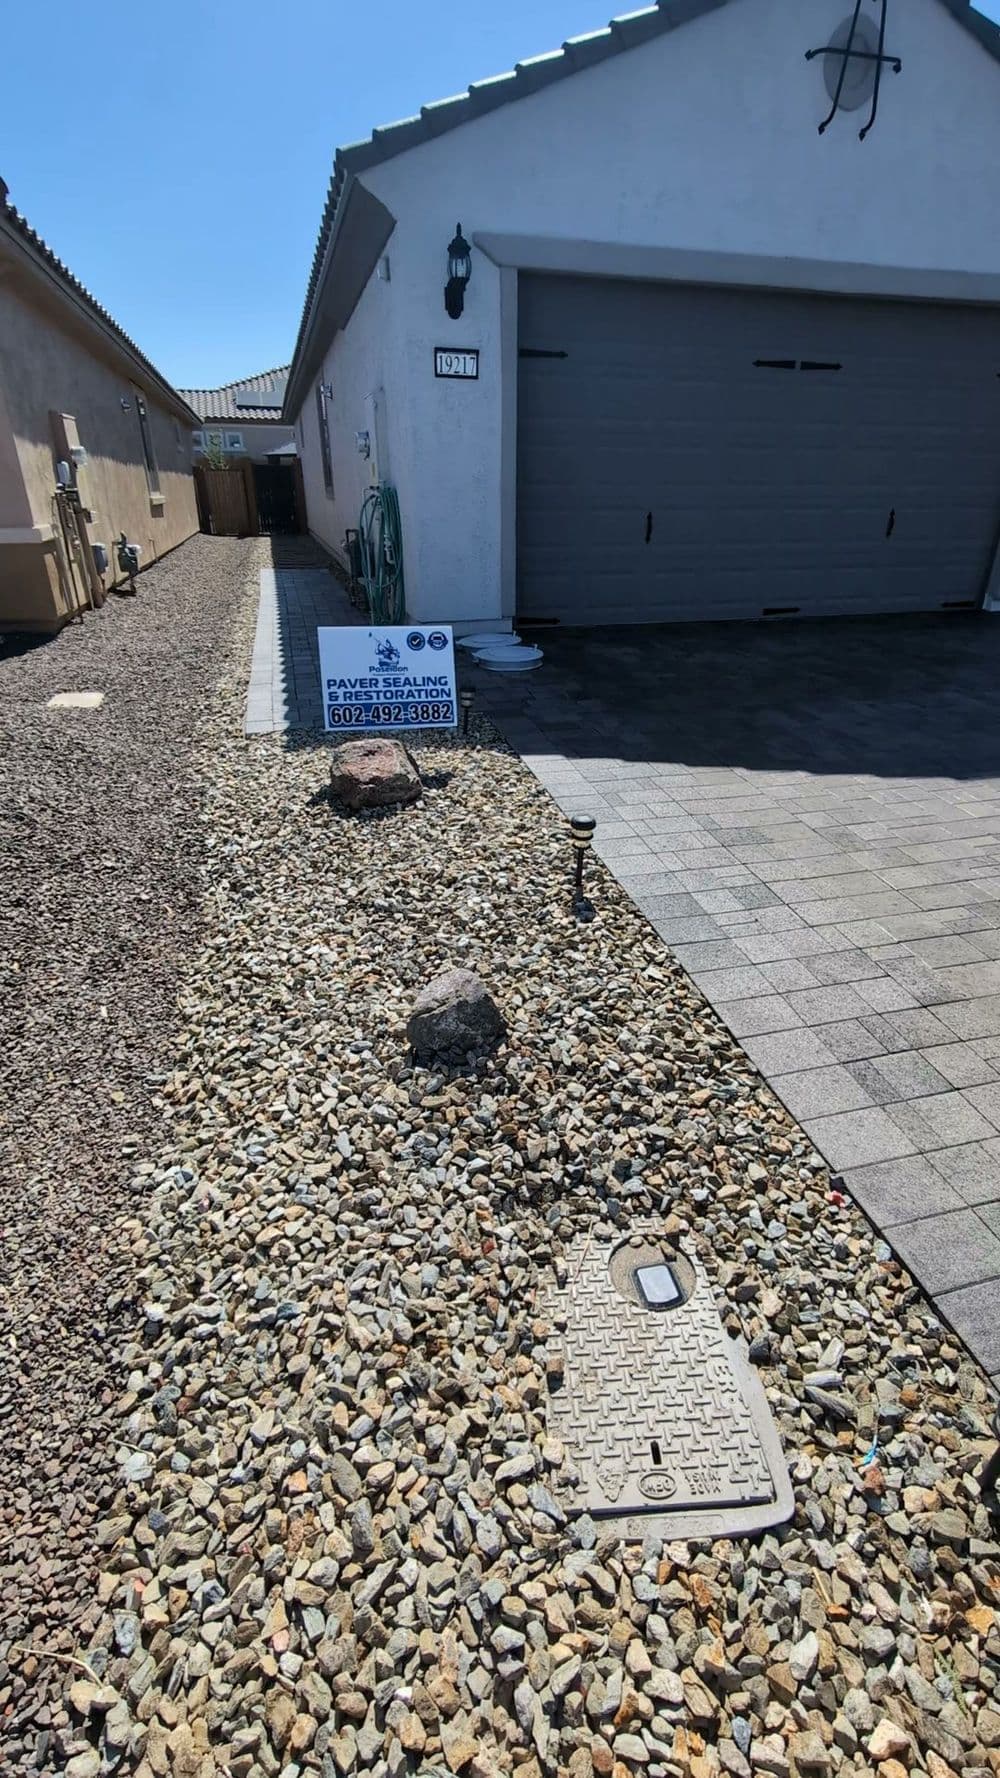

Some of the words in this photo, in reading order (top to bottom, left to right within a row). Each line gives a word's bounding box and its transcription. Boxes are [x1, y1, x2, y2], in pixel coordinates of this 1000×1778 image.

[439, 354, 476, 374] 19217
[369, 665, 409, 673] Poseidon
[327, 678, 379, 690] PAVER
[382, 676, 449, 688] SEALING
[328, 691, 340, 702] &
[343, 688, 452, 702] RESTORATION
[331, 703, 452, 725] 602-492-3882
